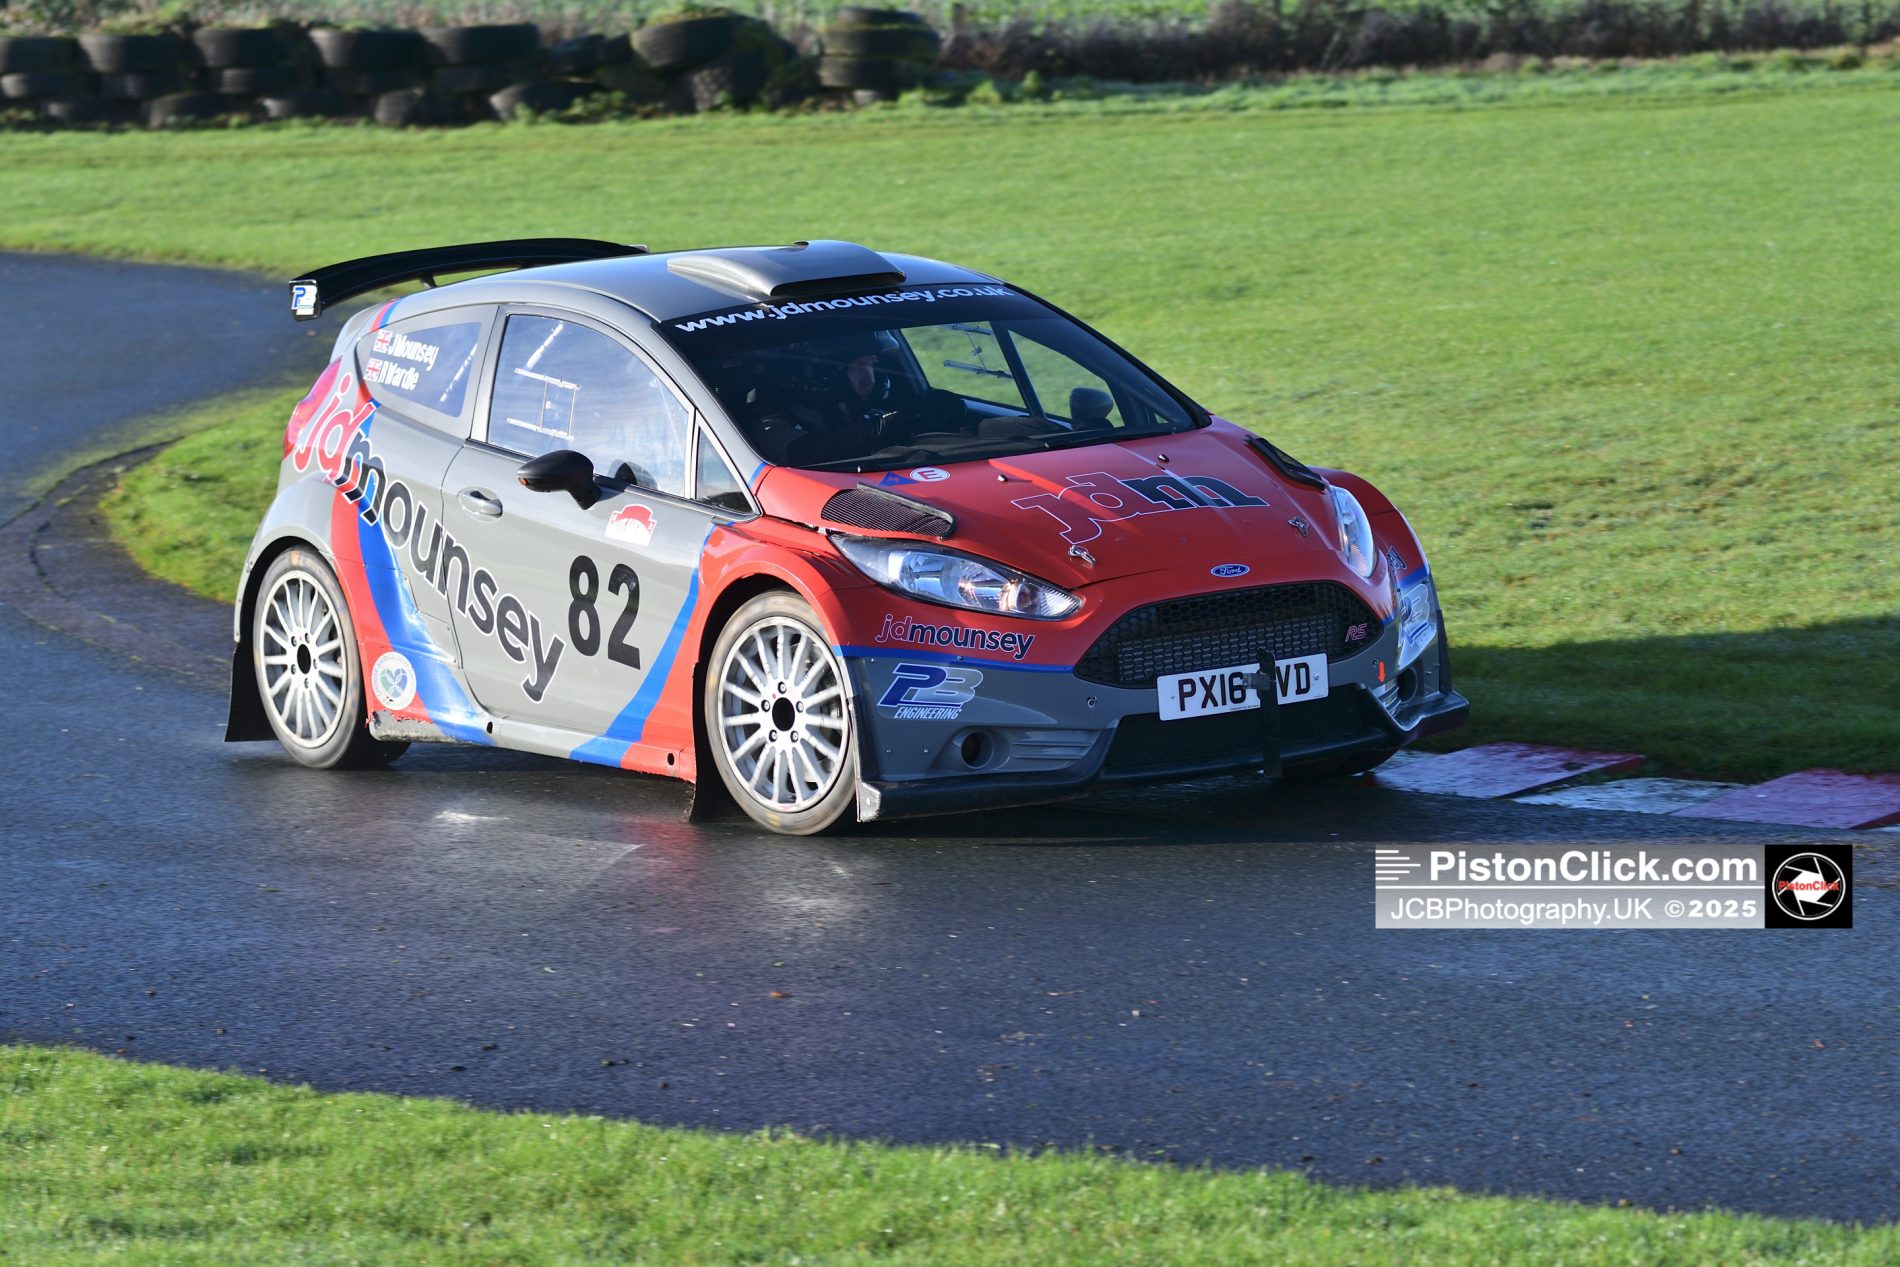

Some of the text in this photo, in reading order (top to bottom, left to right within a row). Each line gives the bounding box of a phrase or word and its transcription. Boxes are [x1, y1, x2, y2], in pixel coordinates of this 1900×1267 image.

[675, 285, 1013, 332] www.jdmounsey.co.uk
[293, 372, 565, 703] jdmounsey
[567, 555, 641, 670] 82
[1345, 623, 1367, 642] RS
[875, 614, 1035, 660] jdmounsey
[1178, 662, 1311, 711] PX16 VD
[894, 706, 962, 720] ENGINEERING
